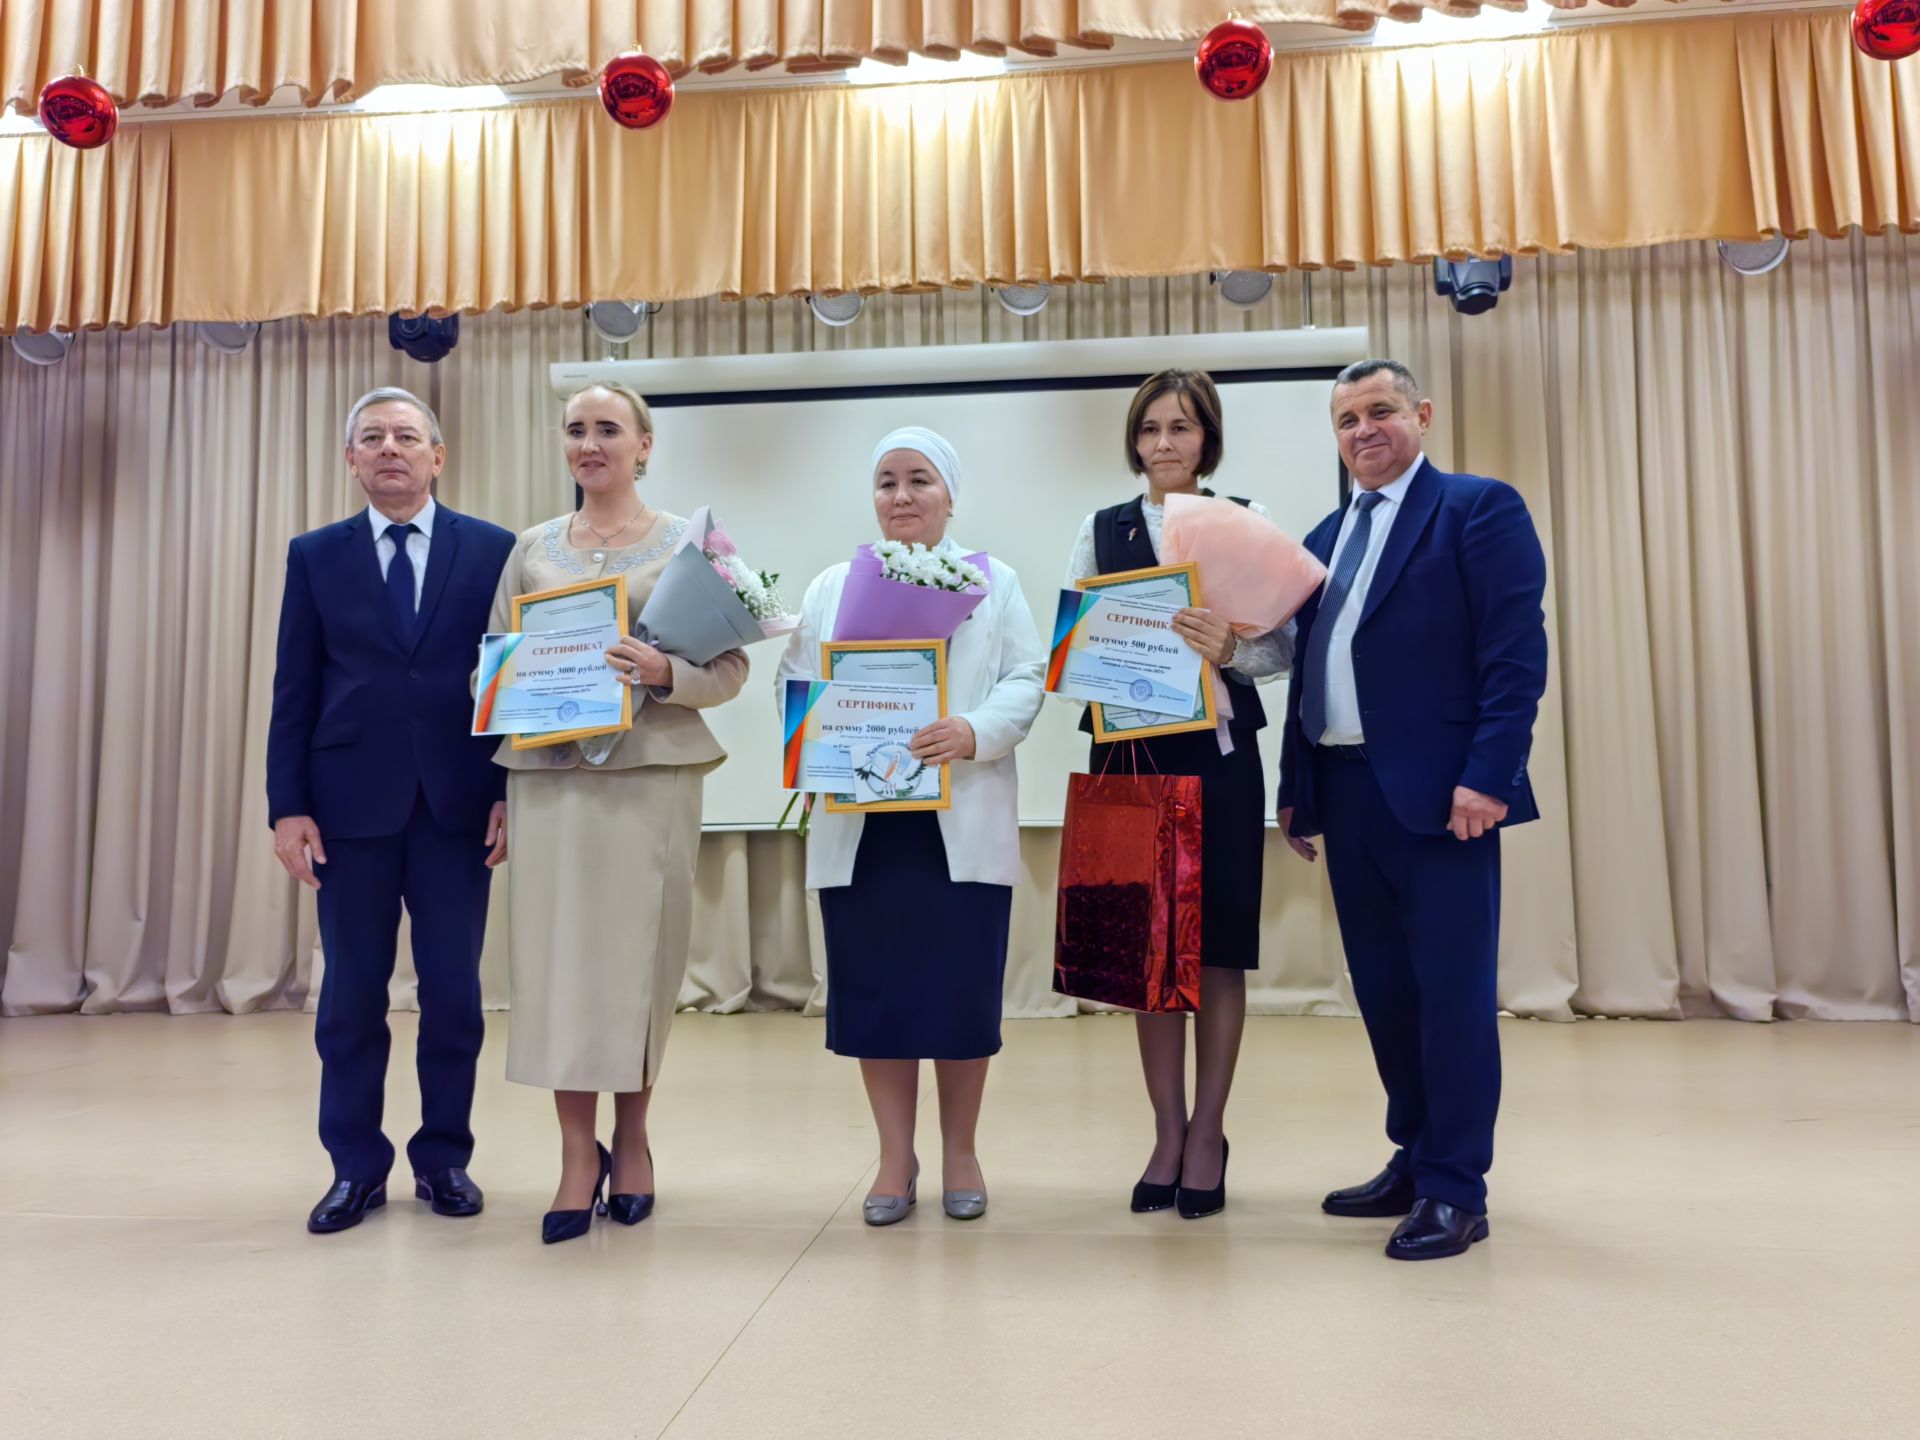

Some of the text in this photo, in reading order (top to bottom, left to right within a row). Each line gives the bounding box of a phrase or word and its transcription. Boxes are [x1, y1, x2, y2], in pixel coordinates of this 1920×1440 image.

[1107, 613, 1170, 630] СЕРТИФИК
[532, 641, 603, 656] СЕРТИФИКАТ
[1101, 637, 1128, 647] сумму
[1130, 640, 1146, 649] 500
[1147, 644, 1179, 655] рублей
[516, 670, 527, 678] на
[528, 669, 555, 679] сумму
[557, 666, 576, 675] 3000
[578, 664, 607, 675] рублей
[837, 699, 916, 711] СЕРТИФИКАТ
[835, 725, 863, 735] сумму
[865, 724, 886, 733] 2000
